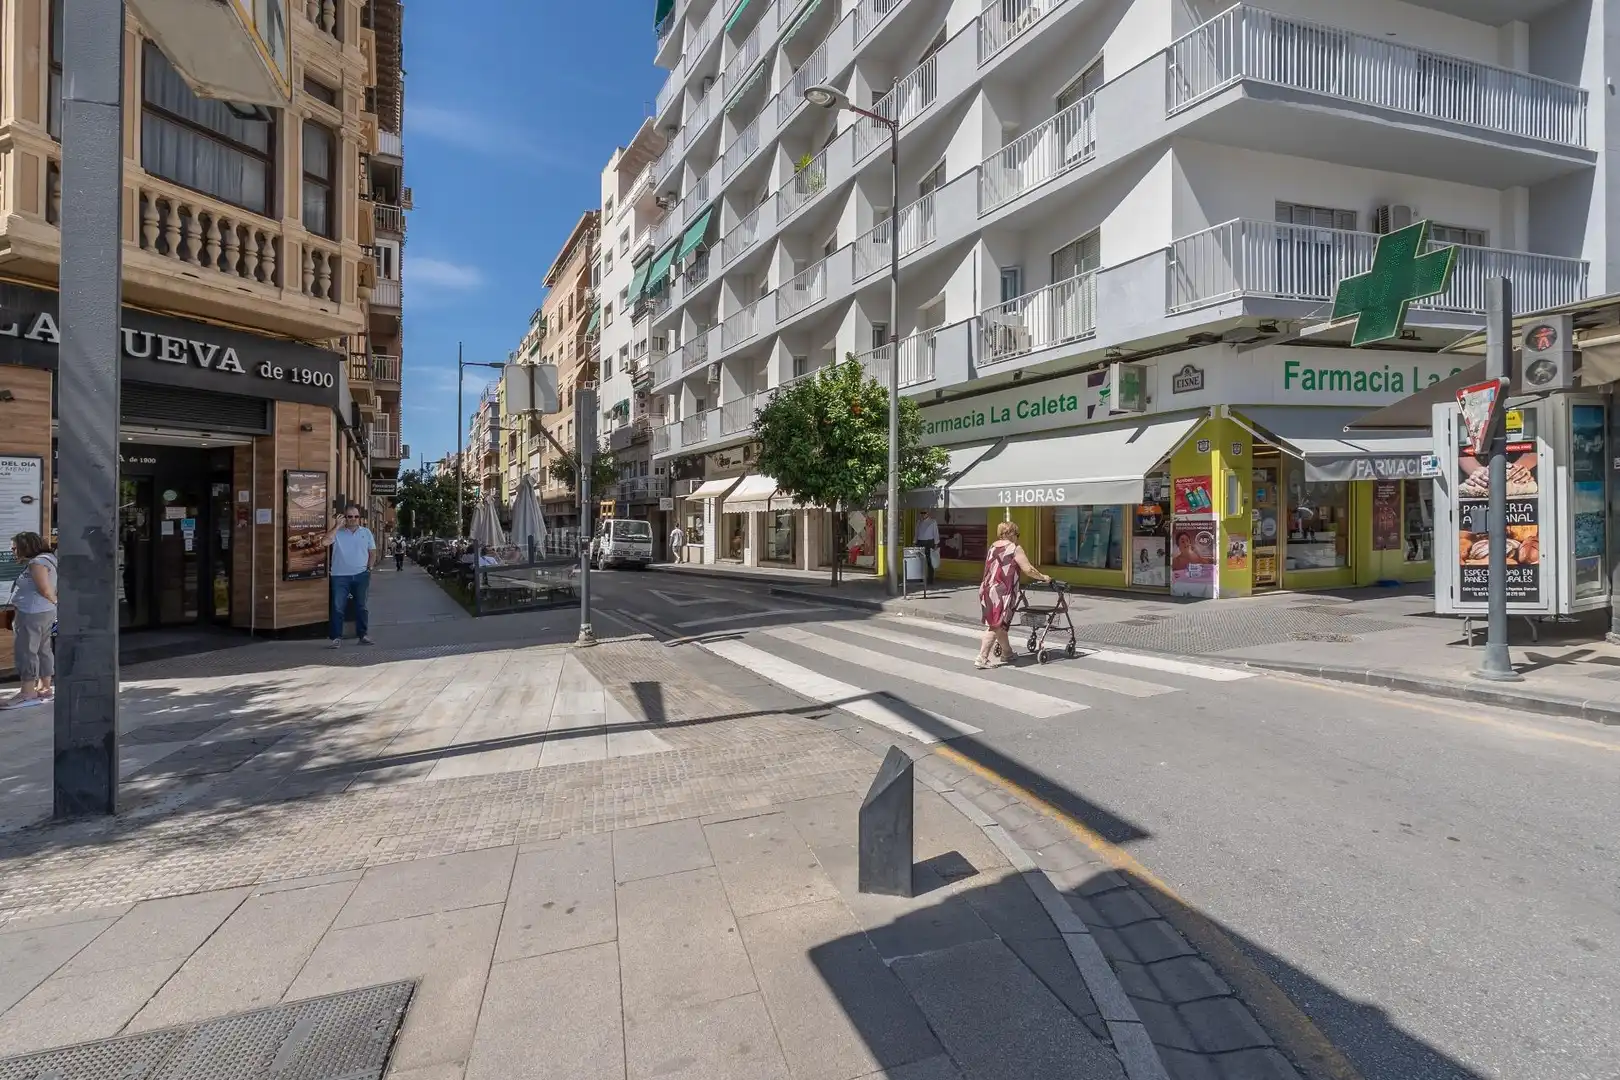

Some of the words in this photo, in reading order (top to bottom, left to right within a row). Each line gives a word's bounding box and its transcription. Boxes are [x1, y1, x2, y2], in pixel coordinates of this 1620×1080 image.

[120, 327, 246, 374] UEVA
[260, 361, 283, 379] de
[292, 367, 334, 388] 1900
[1176, 376, 1200, 388] CISNE
[1284, 361, 1404, 393] Farmacia
[919, 410, 985, 435] Farmacia
[990, 406, 1011, 424] La
[1016, 394, 1078, 419] Caleta
[998, 490, 1012, 504] 13
[1015, 488, 1065, 503] HORAS
[1522, 568, 1533, 576] EN
